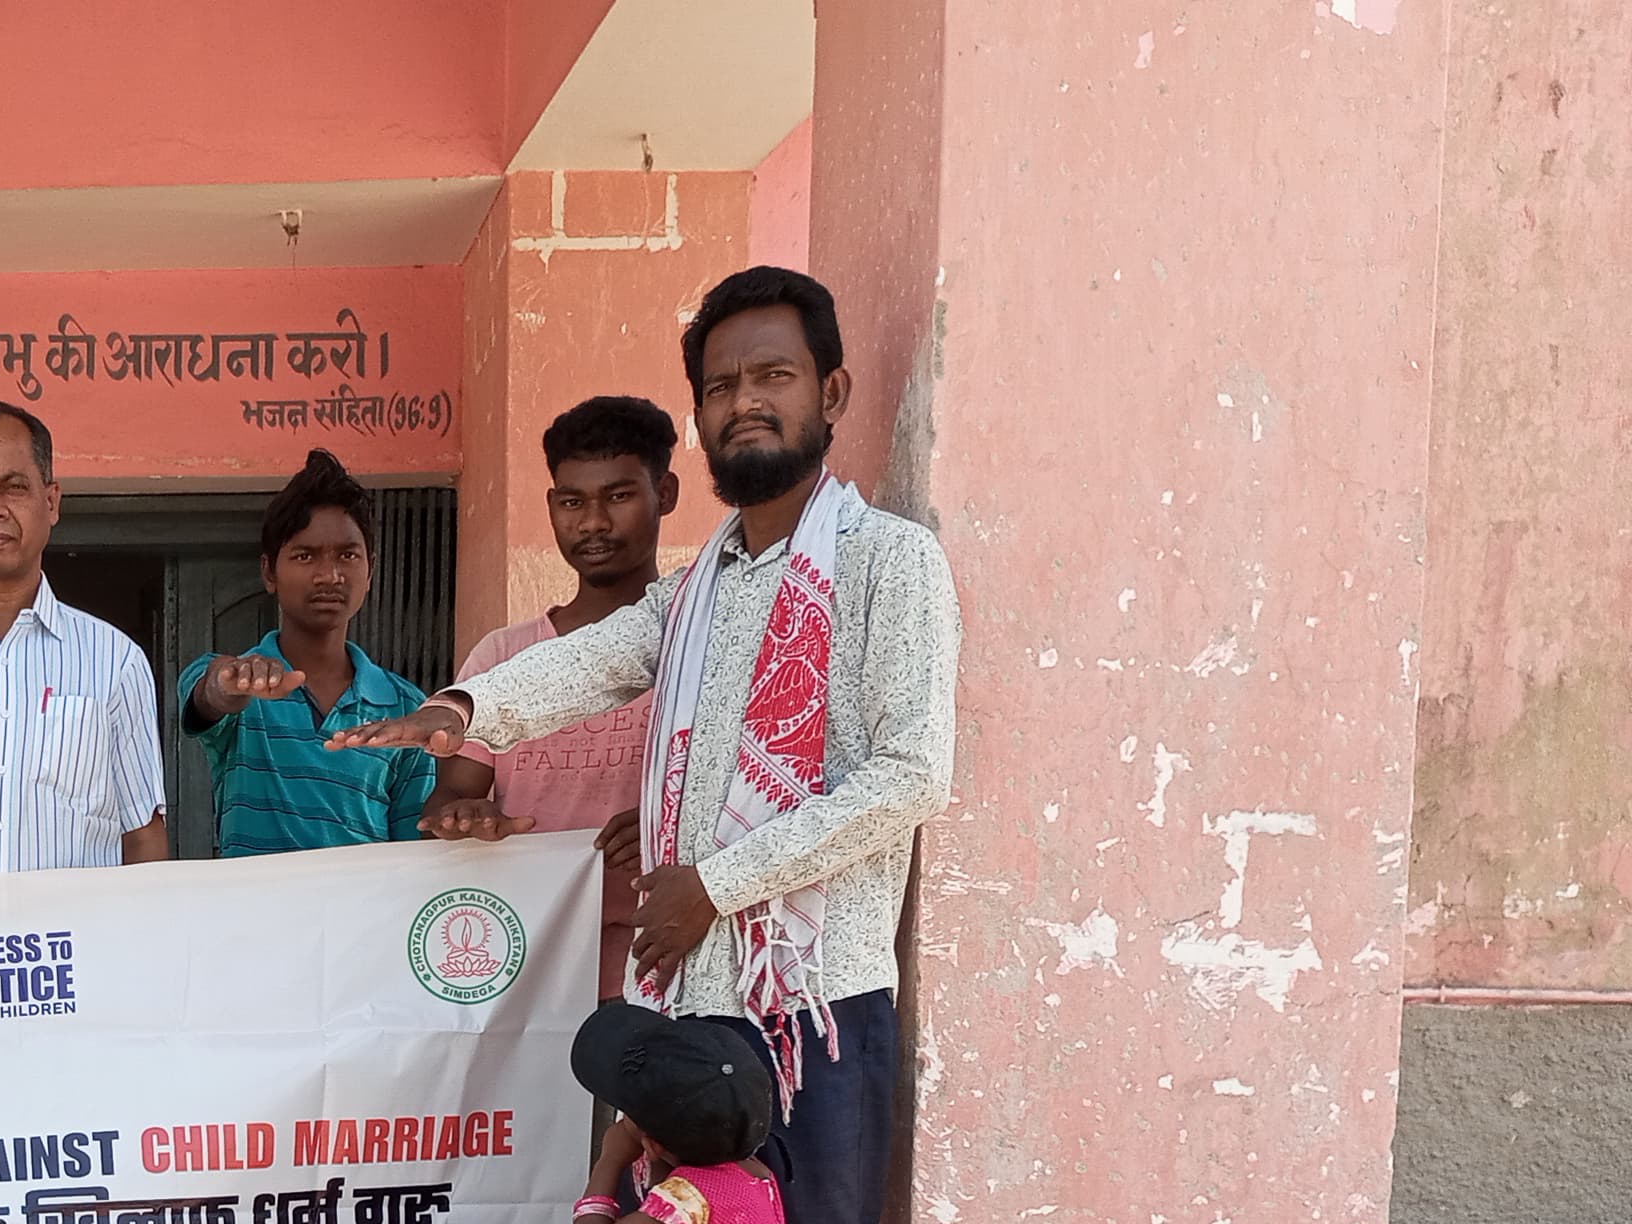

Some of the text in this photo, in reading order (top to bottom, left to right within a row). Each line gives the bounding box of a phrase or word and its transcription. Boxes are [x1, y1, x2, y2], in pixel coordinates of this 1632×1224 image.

[45, 314, 96, 382] की
[102, 331, 276, 386] आराधना
[313, 384, 384, 436] संहिता
[514, 745, 646, 771] FAILUR
[47, 940, 73, 961] TO
[412, 893, 522, 972] CHOTANAGPUR KALYAN NIKETAN
[441, 984, 496, 999] SIMDEGA
[141, 1122, 275, 1173] CHILD
[294, 1110, 514, 1168] MARRIAGE
